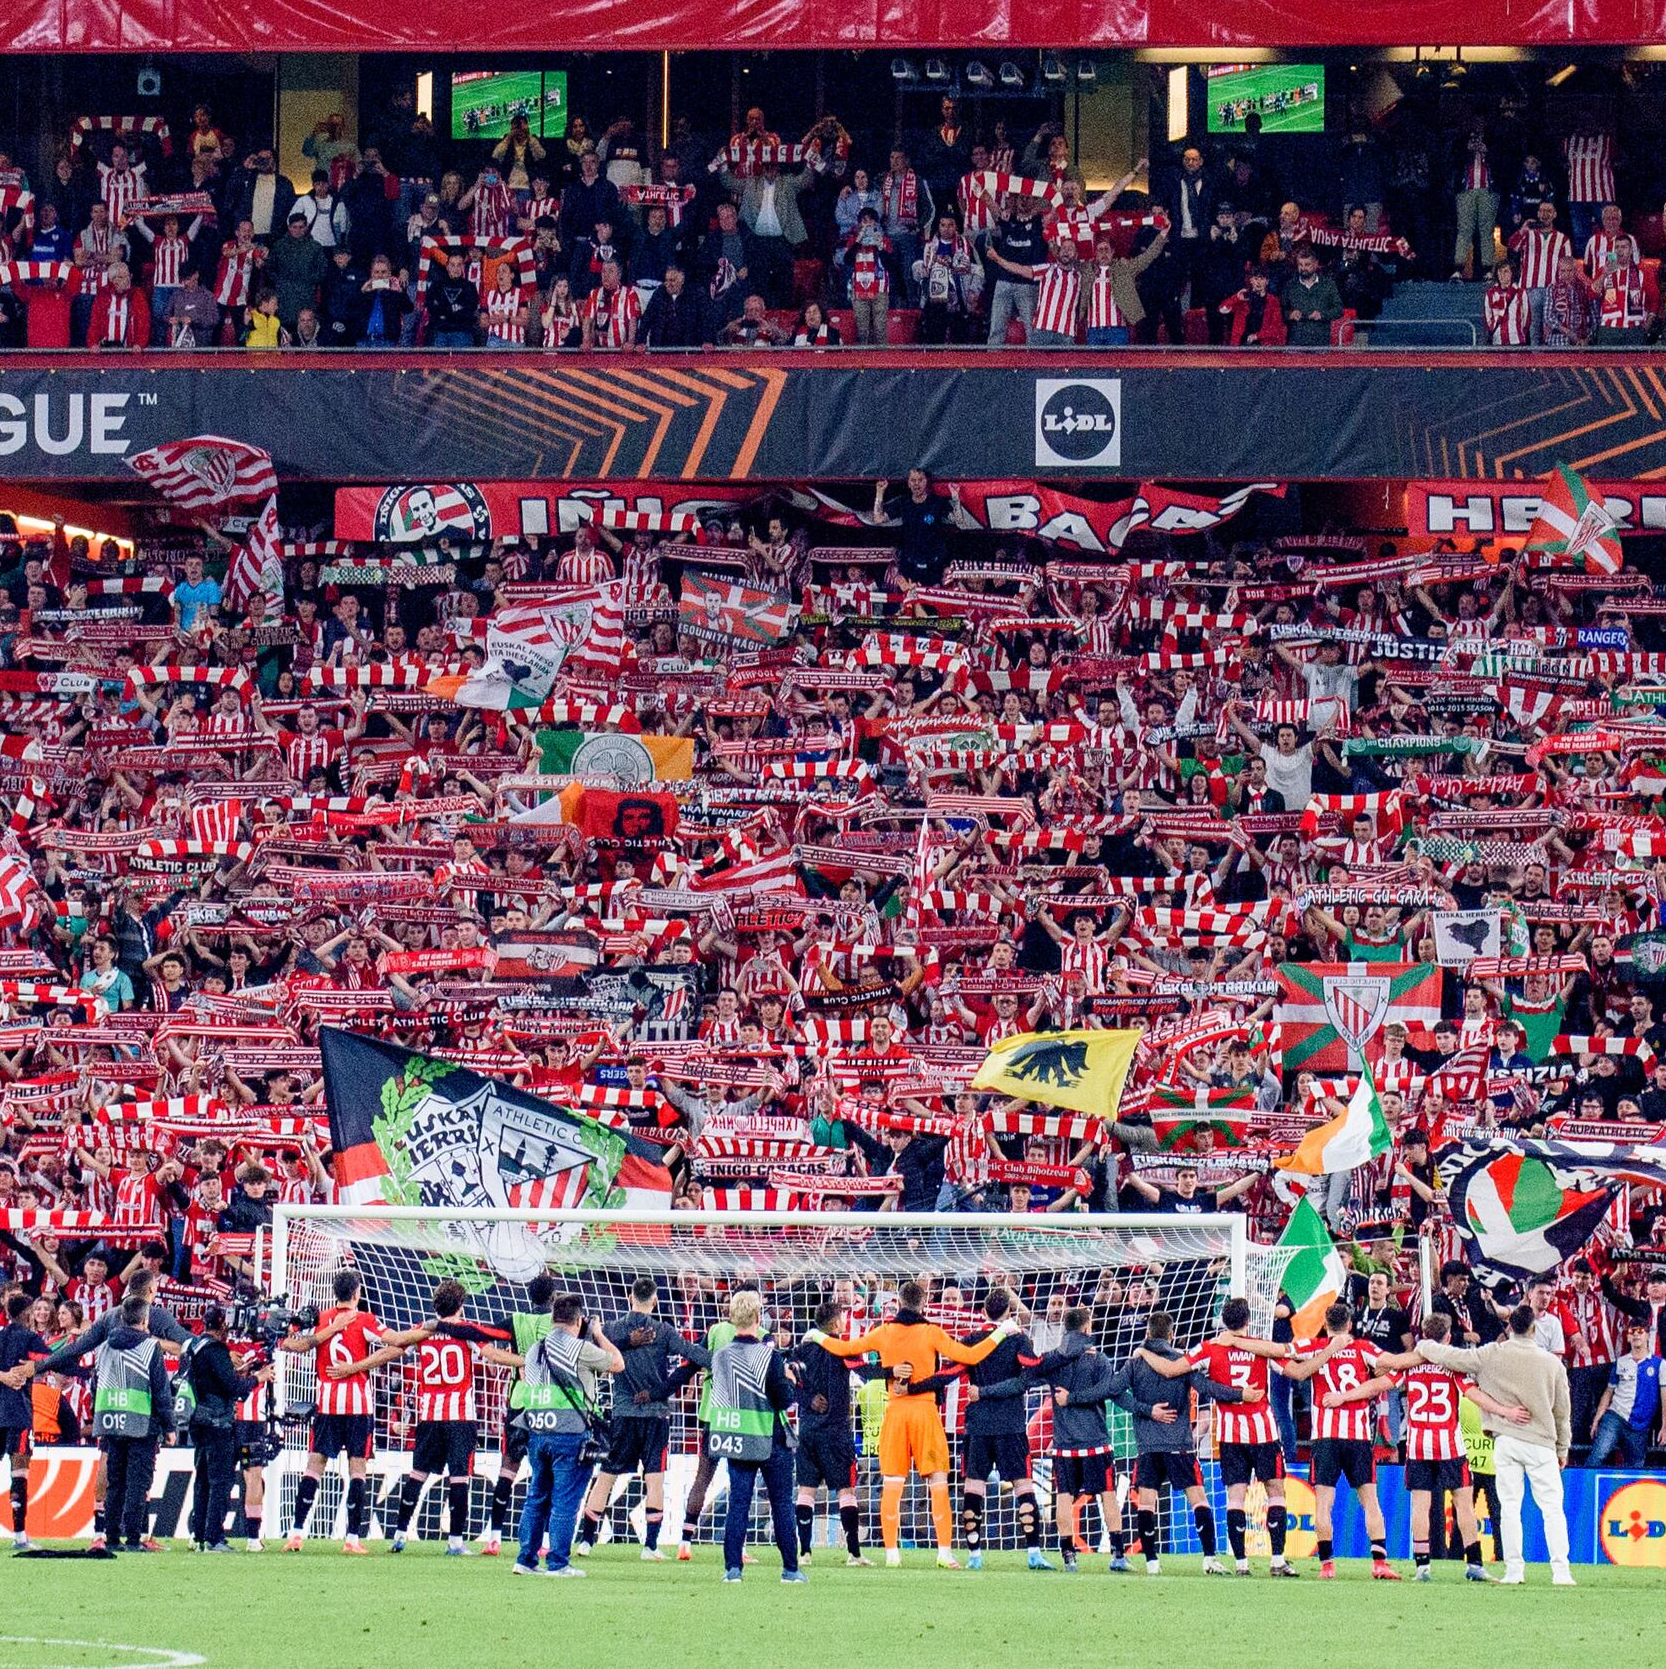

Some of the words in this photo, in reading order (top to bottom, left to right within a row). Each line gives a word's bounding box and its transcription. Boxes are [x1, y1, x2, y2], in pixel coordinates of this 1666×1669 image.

[1578, 632, 1628, 649] RANGERS
[491, 642, 527, 655] EUSKAL
[528, 649, 555, 668] PRESO
[1372, 641, 1449, 661] JUSTIZ
[662, 663, 689, 672] CLUB
[61, 678, 90, 687] CLUB
[1378, 737, 1441, 749] CHAMPIONS
[1424, 774, 1459, 796] Club
[1460, 771, 1526, 796] Athletic
[129, 859, 182, 873] ATHLETIC
[185, 862, 218, 874] CLUB
[1308, 891, 1368, 904] ATHLETIC
[1372, 891, 1392, 902] GU
[353, 993, 385, 1003] CLUB
[823, 996, 852, 1005] CLUB
[855, 988, 893, 1003] ATHLETIC
[392, 1016, 449, 1027] ATHLETIC
[453, 1011, 486, 1022] CLUB
[33, 1111, 61, 1121] CLUB
[473, 1105, 548, 1142] ATHLETIC
[1569, 1124, 1595, 1134] AUPA
[1596, 1125, 1649, 1137] ATHLETIC
[760, 1163, 827, 1176] CABACAS
[1004, 1163, 1024, 1173] Club
[1027, 1165, 1070, 1178] Bihotzean
[330, 1333, 354, 1368] 6
[1228, 1351, 1256, 1363] VIVIAN
[421, 1345, 465, 1385] 20
[1230, 1365, 1252, 1389] 3
[1319, 1362, 1363, 1396] 18
[107, 1391, 128, 1407] HB
[530, 1387, 550, 1405] HB
[1408, 1381, 1452, 1423] 23
[102, 1413, 127, 1430] 019
[716, 1411, 741, 1429] HB
[710, 1436, 744, 1454] 043
[1470, 1456, 1487, 1468] 47
